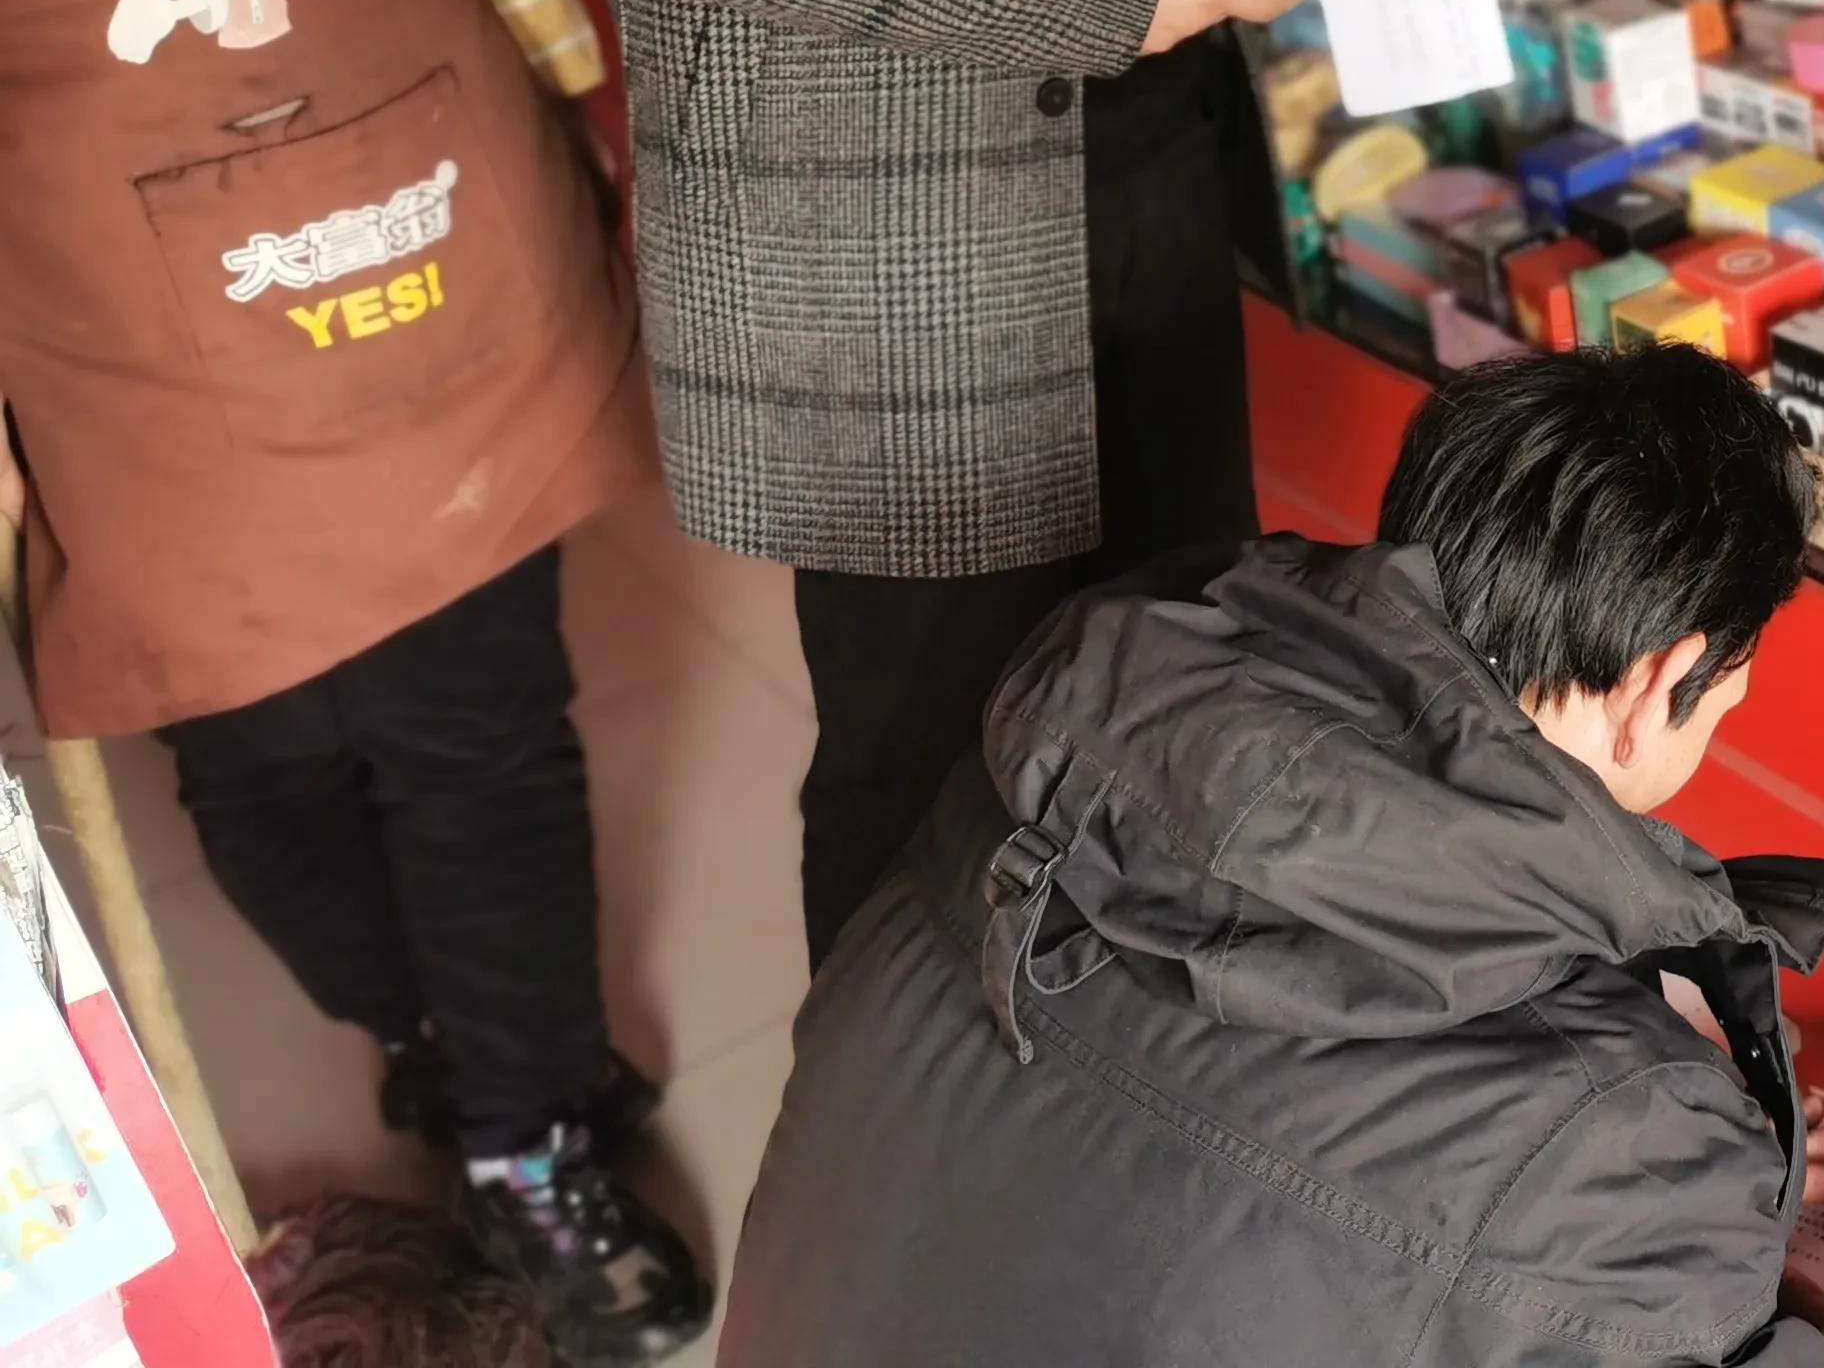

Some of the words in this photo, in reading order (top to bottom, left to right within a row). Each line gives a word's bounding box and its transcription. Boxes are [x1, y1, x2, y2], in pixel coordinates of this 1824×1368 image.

[222, 172, 453, 303] 大富翁
[286, 262, 444, 349] YES!
